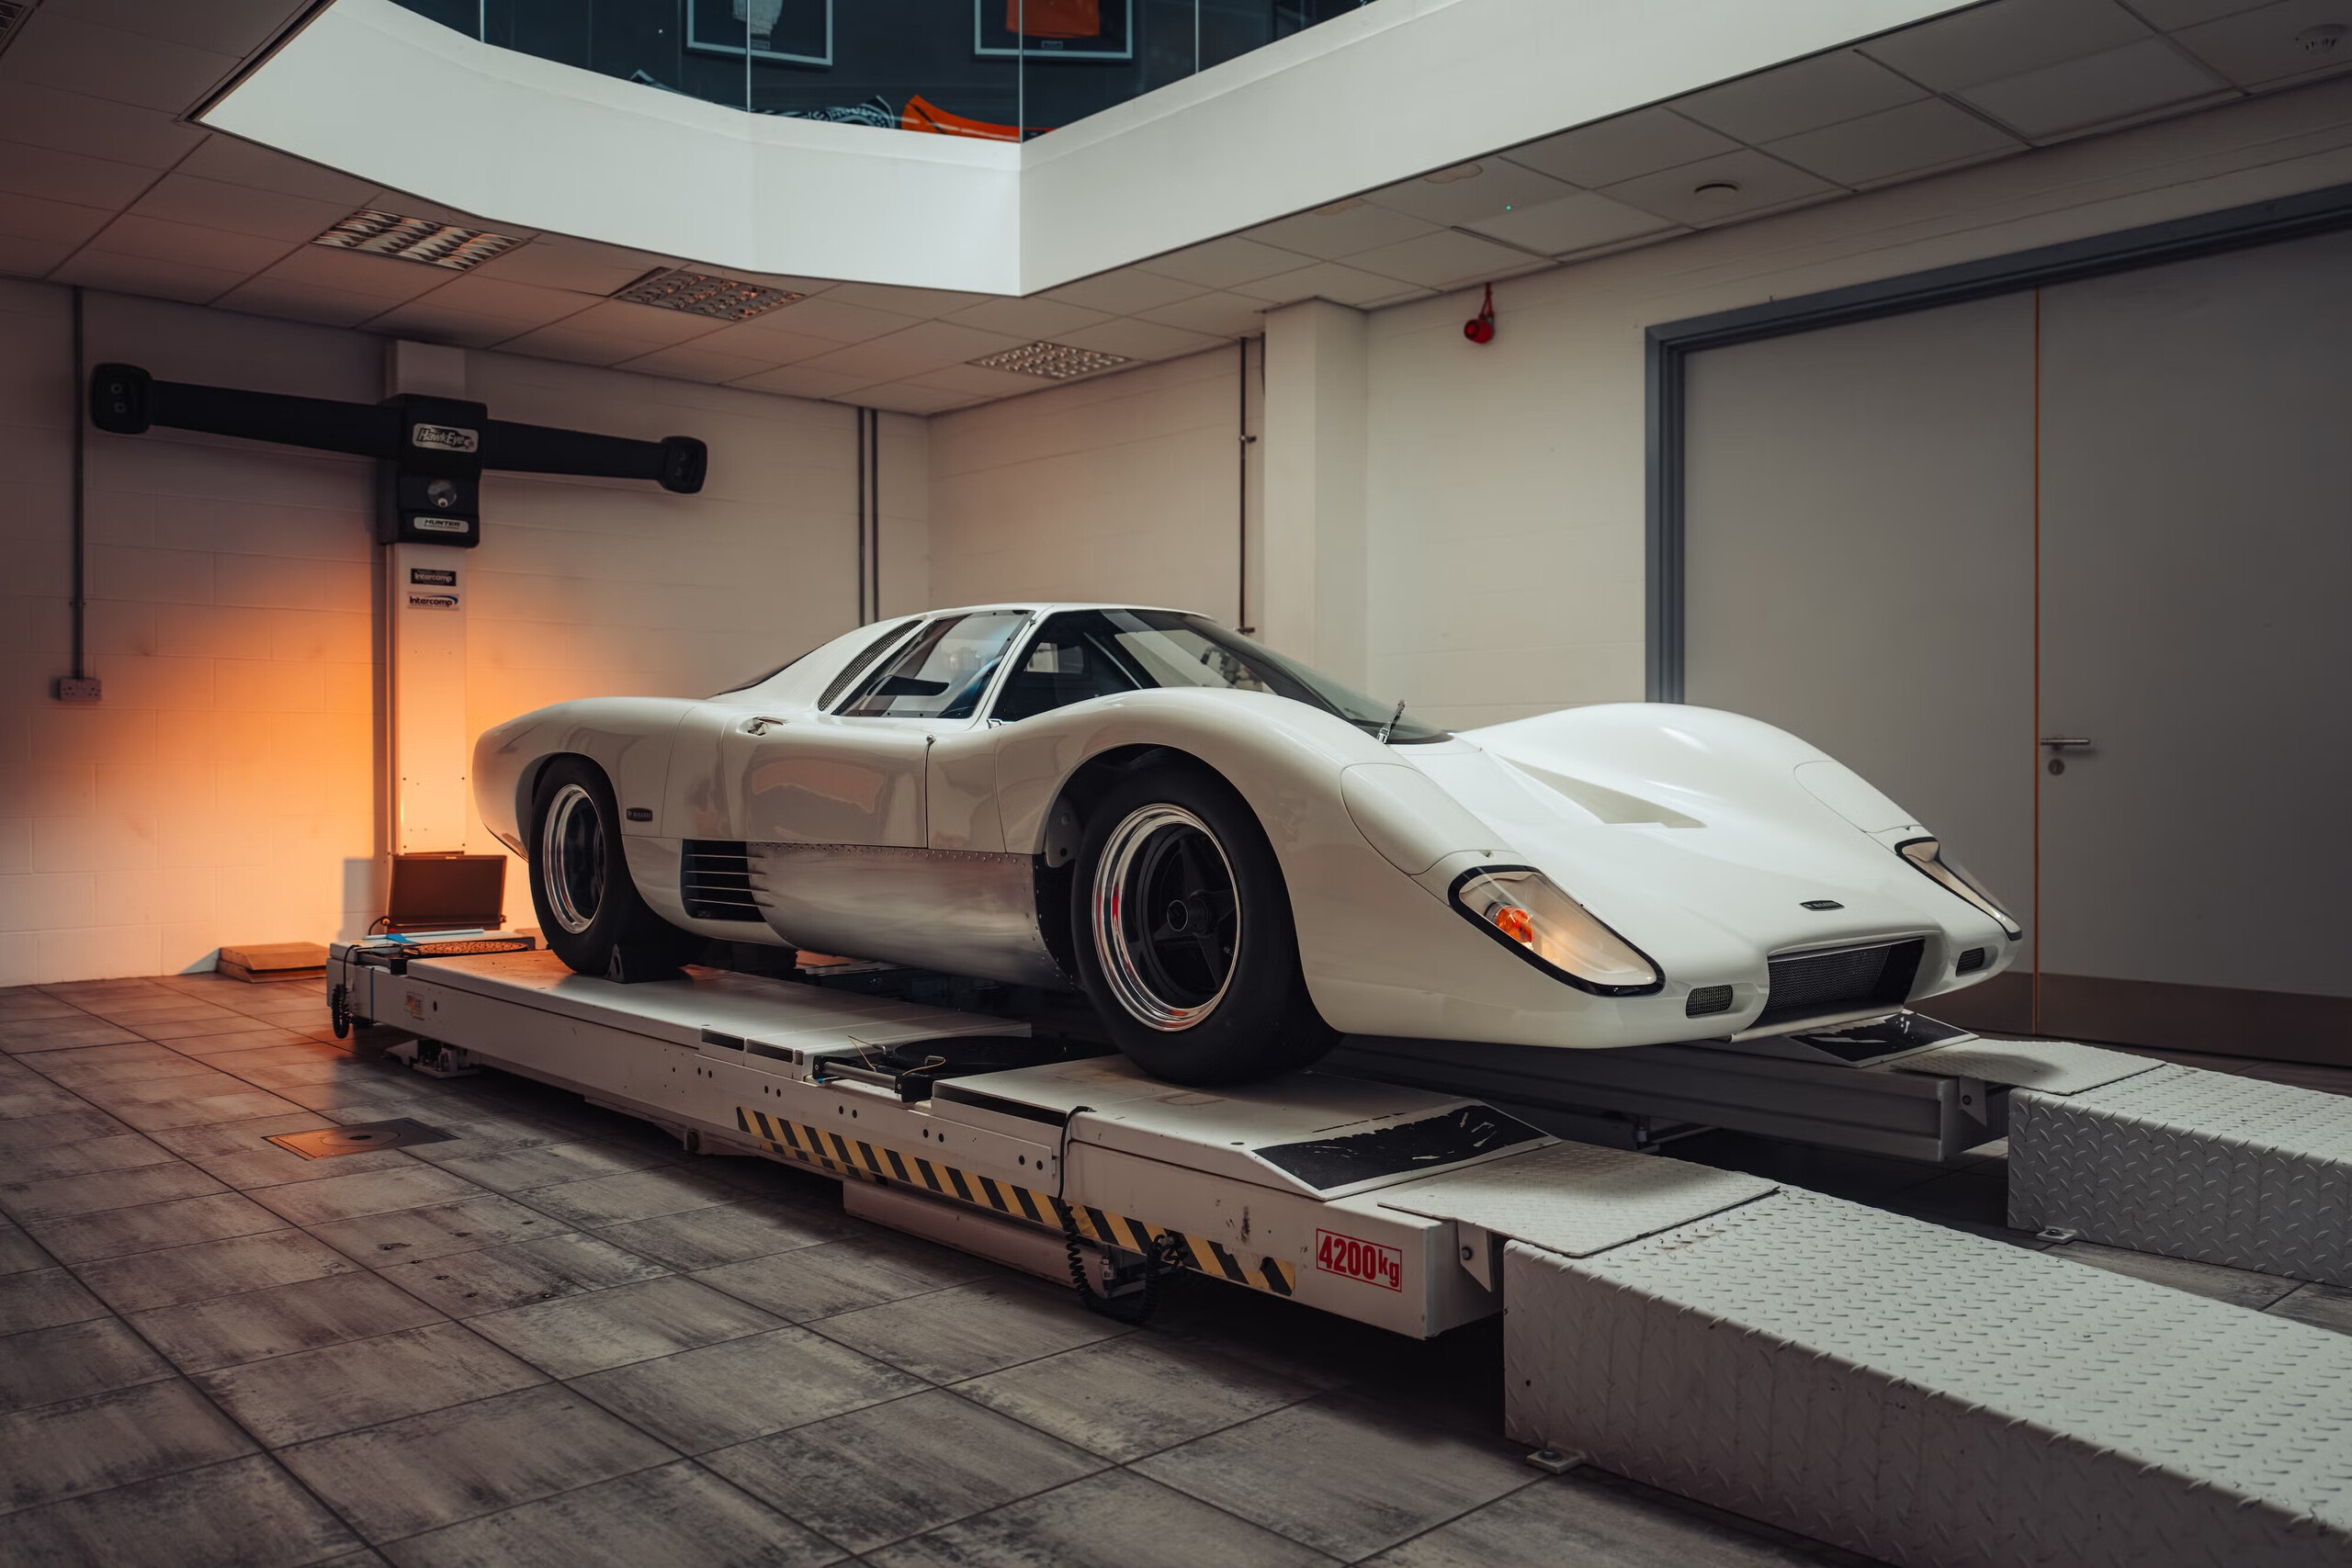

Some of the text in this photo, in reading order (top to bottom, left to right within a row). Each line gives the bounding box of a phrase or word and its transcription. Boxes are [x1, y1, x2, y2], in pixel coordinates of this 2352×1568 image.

[418, 428, 465, 446] HawkEye
[424, 519, 460, 527] HUNTER
[414, 572, 452, 583] Intercomp
[410, 595, 453, 607] Intercomp
[1318, 1235, 1400, 1288] 4200kg
